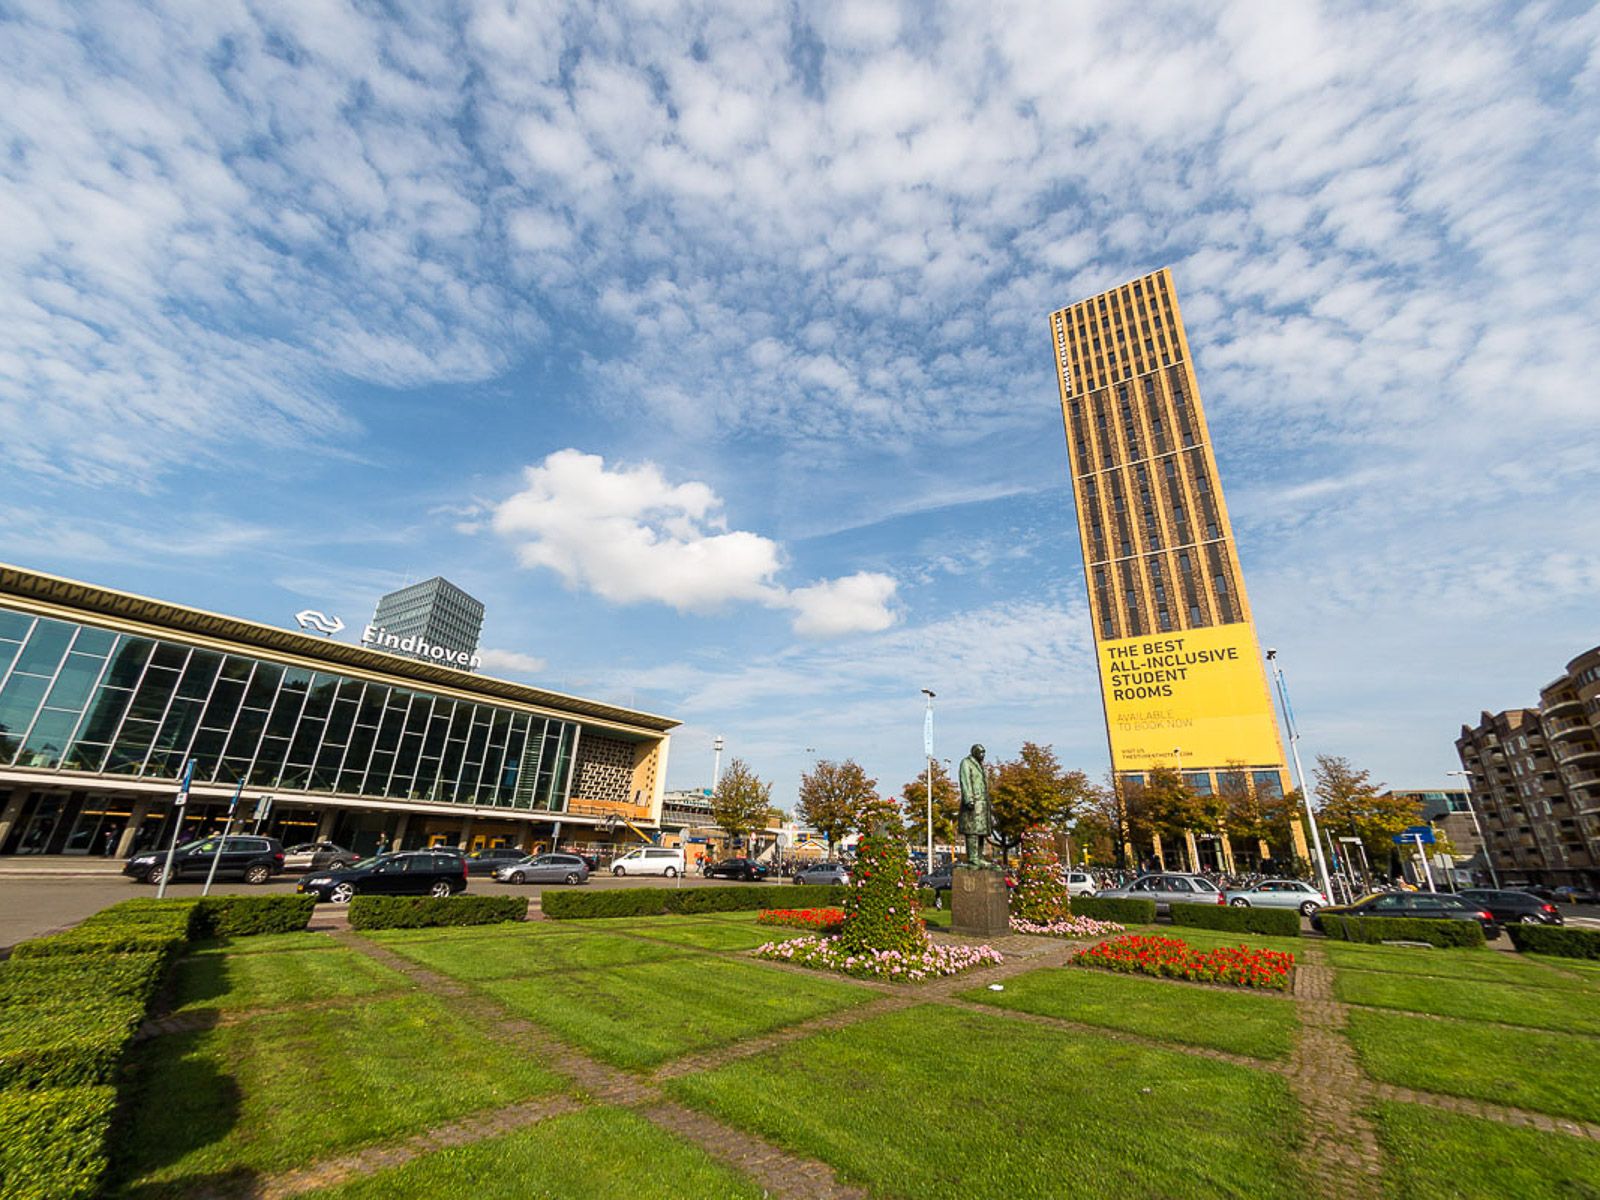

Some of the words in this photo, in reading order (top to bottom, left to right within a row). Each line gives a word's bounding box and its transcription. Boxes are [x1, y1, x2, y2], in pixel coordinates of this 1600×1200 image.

[362, 624, 482, 668] Eindhoven
[1107, 644, 1139, 659] THE
[1143, 638, 1185, 655] BEST
[1110, 647, 1239, 673] ALL-INCLUSIVE
[1112, 668, 1188, 687] STUDENT
[1113, 684, 1173, 701] ROOMS
[1116, 709, 1174, 721] AVAILABLE
[1117, 722, 1131, 731] TO
[1134, 720, 1165, 731] BOOK
[1167, 717, 1193, 728] NOW
